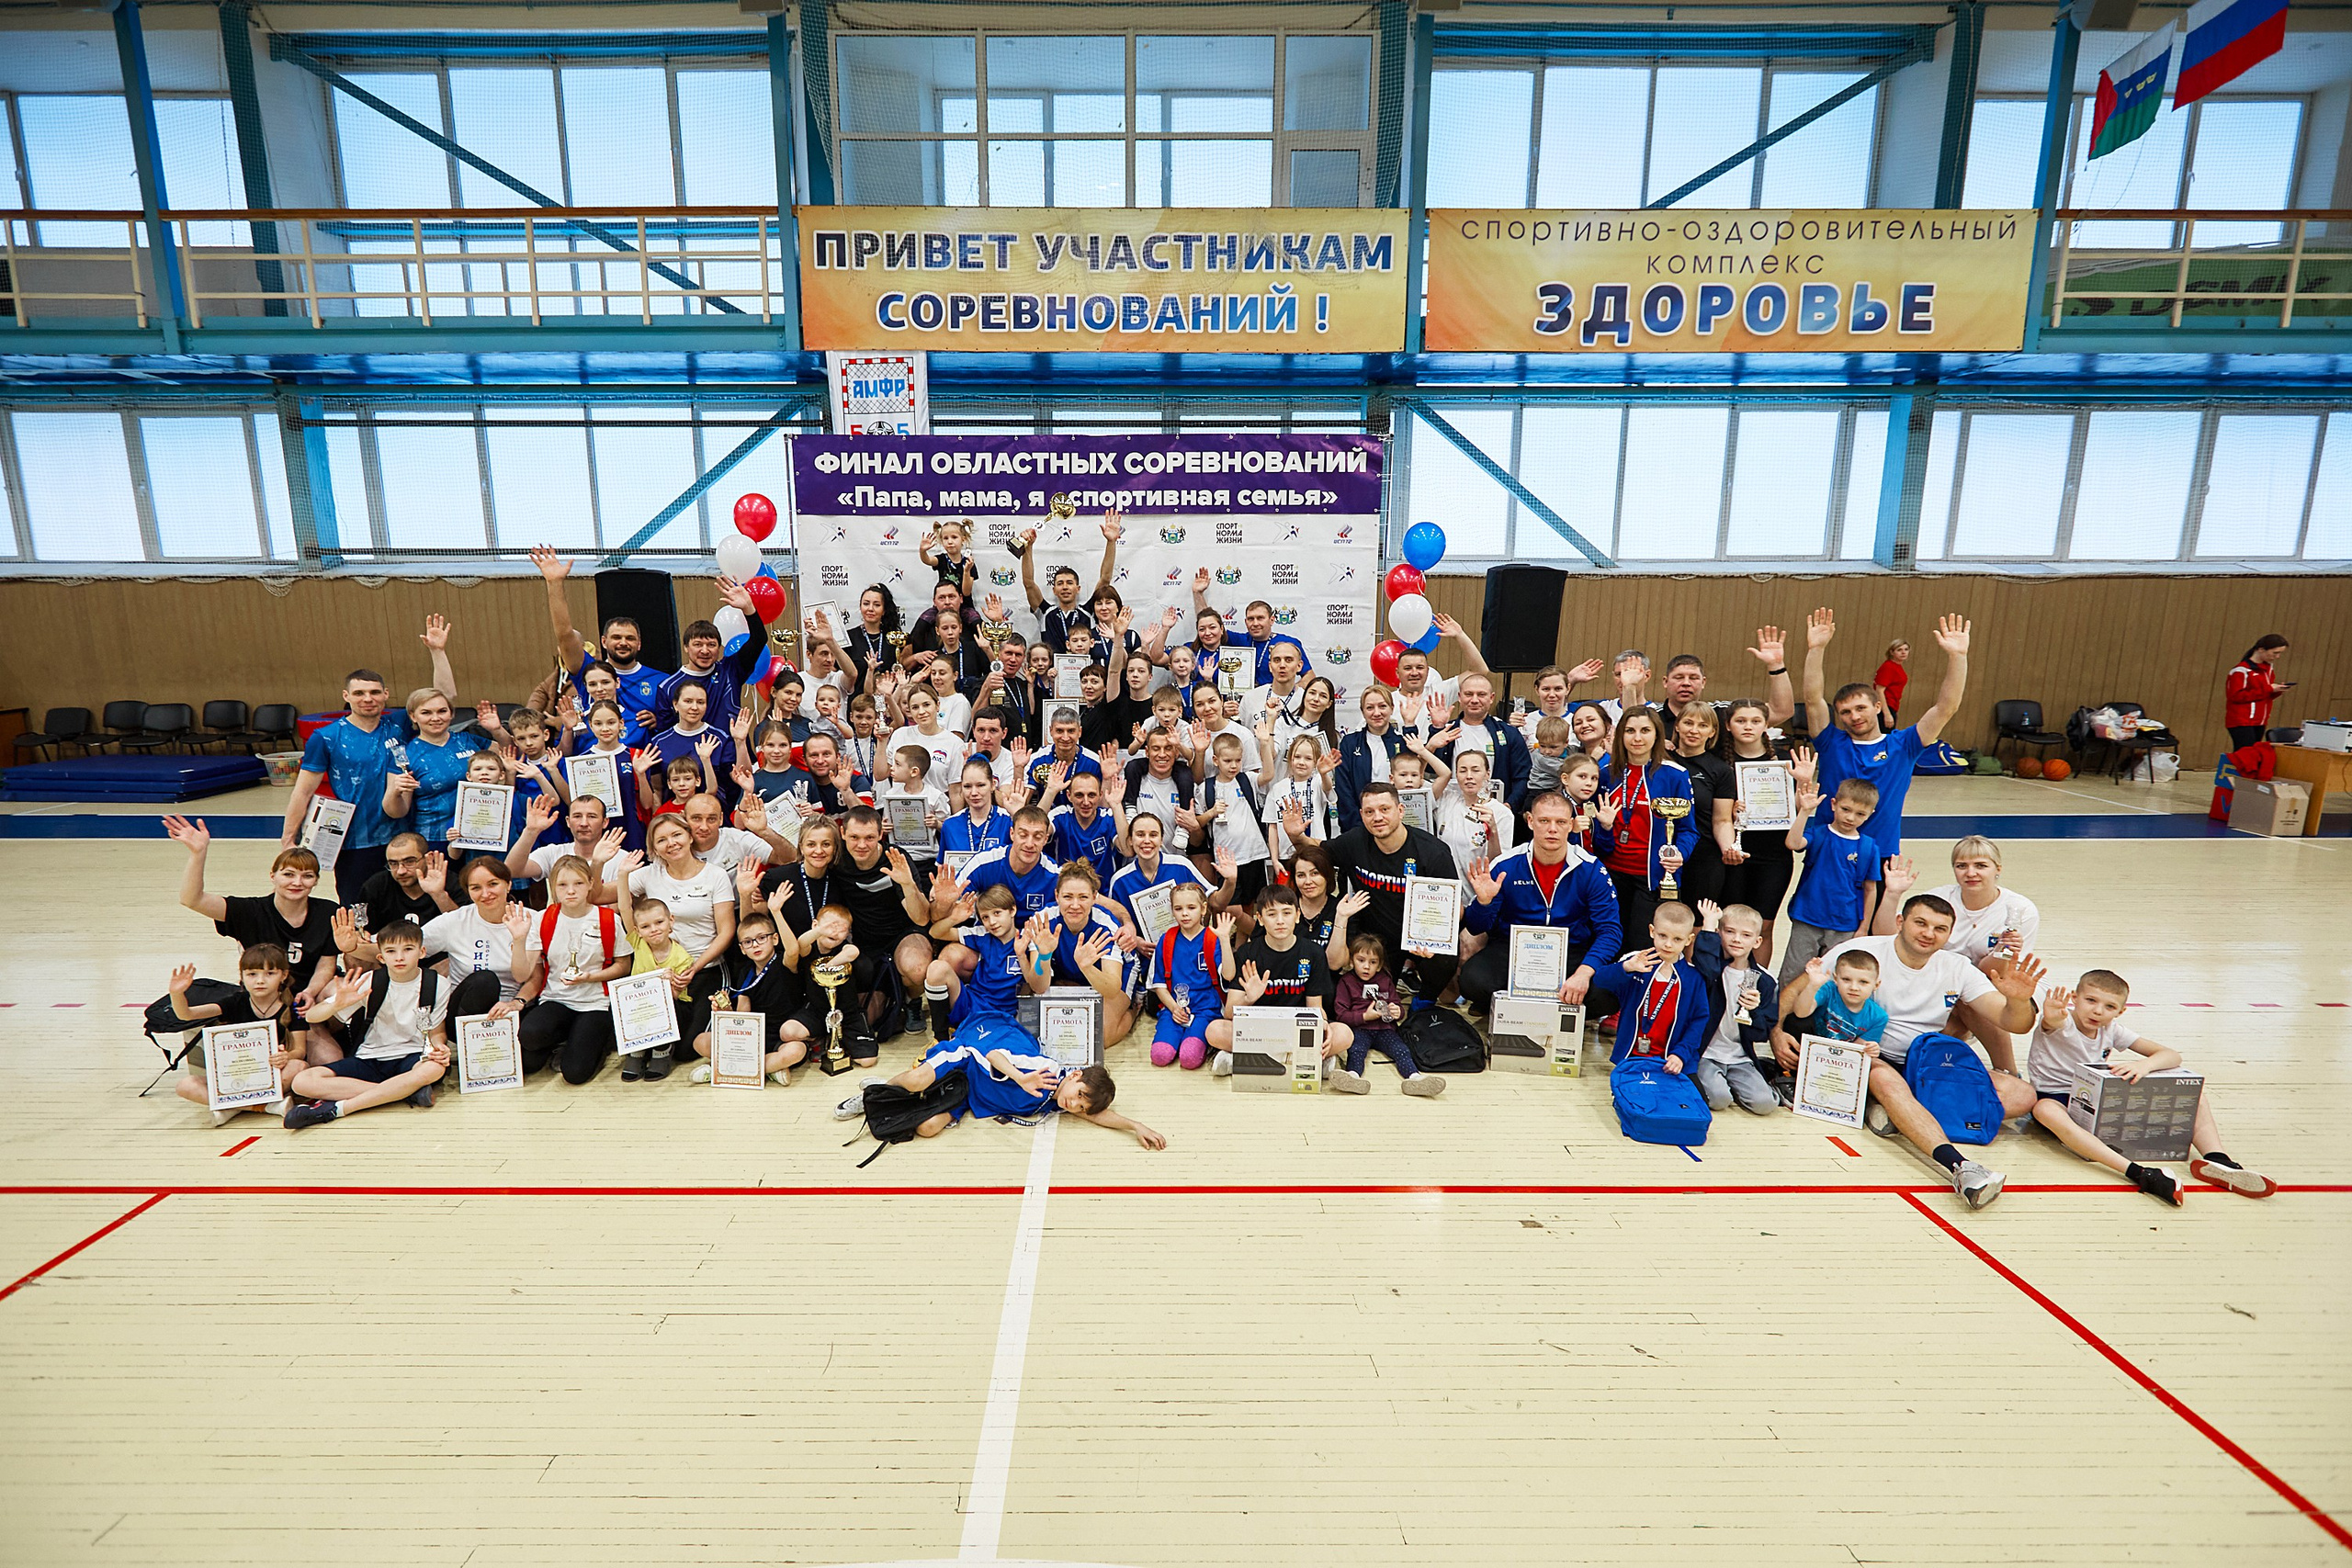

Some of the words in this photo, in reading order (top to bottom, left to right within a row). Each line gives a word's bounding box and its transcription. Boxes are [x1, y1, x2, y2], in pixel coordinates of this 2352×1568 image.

[1461, 213, 2017, 245] спортивно-оздоровительный
[813, 231, 1017, 271] ПРИВЕТ
[1035, 232, 1394, 273] УЧАСТНИКАМ
[1646, 252, 1825, 275] комплекс
[876, 282, 1298, 333] СОРЕВНОВАНИЙ
[1314, 289, 1330, 333] !
[1532, 280, 1939, 346] ЗДОРОВЬЕ
[853, 378, 905, 398] АМФР
[814, 451, 923, 475] ФИНАЛ
[930, 451, 1117, 475] ОБЛАСТНЫХ
[1124, 446, 1367, 473] СОРЕВНОВАНИЙ
[837, 487, 933, 512] «Папа,
[939, 490, 1021, 512] мама,
[1028, 491, 1045, 507] я
[1068, 490, 1230, 512] спортивная
[1237, 489, 1338, 509] семья»
[288, 942, 303, 964] 5
[625, 988, 659, 1001] ГРАМОТА
[222, 1041, 263, 1051] ГРАМОТА
[471, 1031, 507, 1039] ГРАМОТА
[1815, 1056, 1854, 1069] ГРАМОТА
